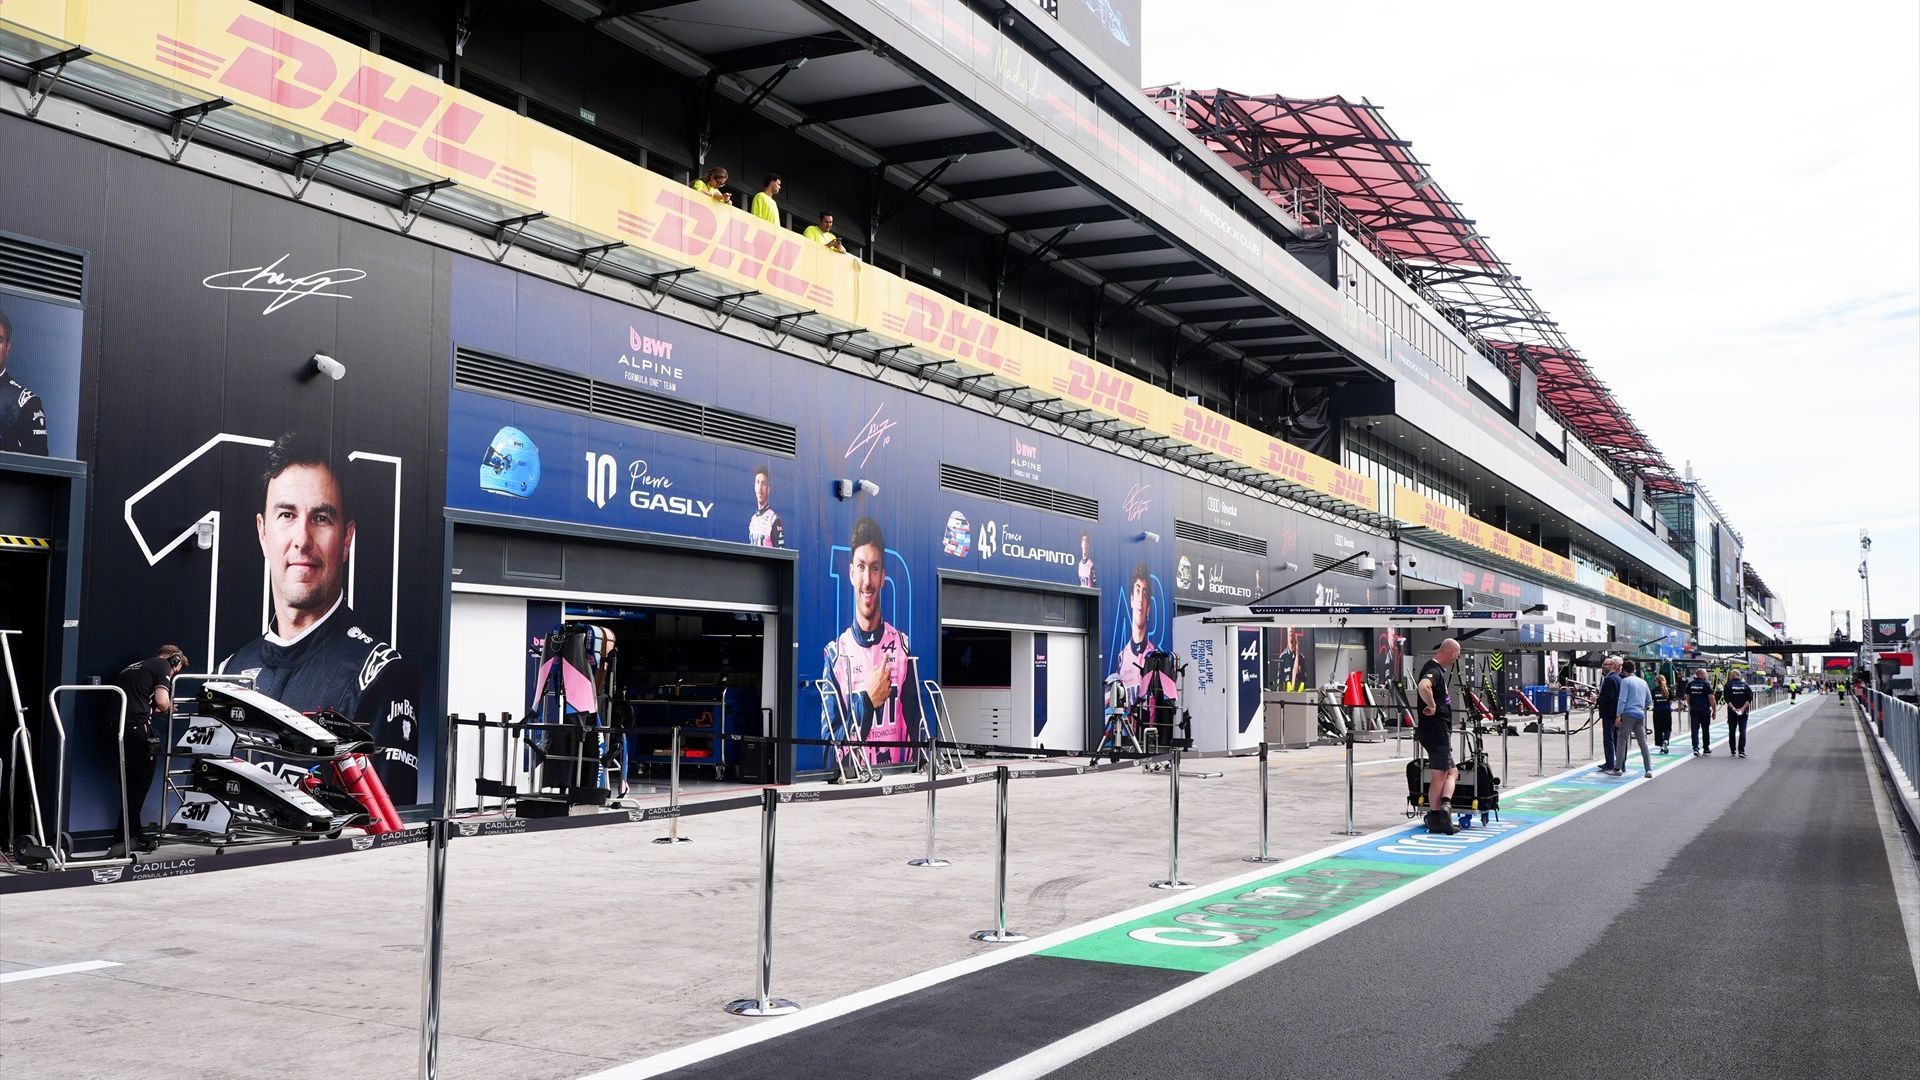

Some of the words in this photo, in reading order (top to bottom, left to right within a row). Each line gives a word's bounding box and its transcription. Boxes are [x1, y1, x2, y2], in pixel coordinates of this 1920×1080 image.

[994, 46, 1040, 98] Madrid
[218, 14, 497, 180] DHL
[1200, 204, 1239, 241] PADDOCK
[1240, 234, 1259, 256] CLUB
[651, 189, 811, 296] DHL
[902, 292, 1005, 369] DHL
[643, 336, 673, 360] BWT
[618, 354, 683, 380] ALPINE
[624, 371, 648, 385] FORMULA
[663, 381, 677, 392] TEAM
[1067, 359, 1137, 419] DHL
[1182, 407, 1235, 458] DHL
[1022, 444, 1036, 459] BWT
[1267, 442, 1307, 482] DHL
[629, 460, 673, 490] Pierre
[1010, 457, 1042, 472] ALPINE
[585, 451, 617, 509] 10
[1333, 470, 1366, 505] DHL
[630, 490, 714, 518] GASLY
[1425, 503, 1447, 531] DHL
[978, 520, 996, 559] 43
[1002, 524, 1022, 541] Franco
[1461, 518, 1481, 544] DHL
[1002, 543, 1075, 566] COLAPINTO
[1197, 564, 1205, 591] 5
[1209, 583, 1252, 598] BORTOLETO
[1190, 640, 1198, 660] TEAM
[1198, 640, 1206, 674] FORMULA
[1205, 640, 1213, 656] BWT
[1205, 658, 1214, 684] ALPINE
[230, 708, 244, 721] FIA
[387, 700, 403, 722] JIM
[187, 727, 215, 746] 3M
[976, 771, 994, 780] CADILLAC
[227, 782, 240, 793] FIA
[182, 803, 210, 822] 3M
[648, 806, 680, 815] CADILLAC
[381, 828, 428, 841] CADILLAC
[485, 820, 526, 829] CADILLAC
[381, 839, 407, 847] FORMULA
[133, 859, 196, 873] CADILLAC
[133, 872, 167, 881] FORMULA
